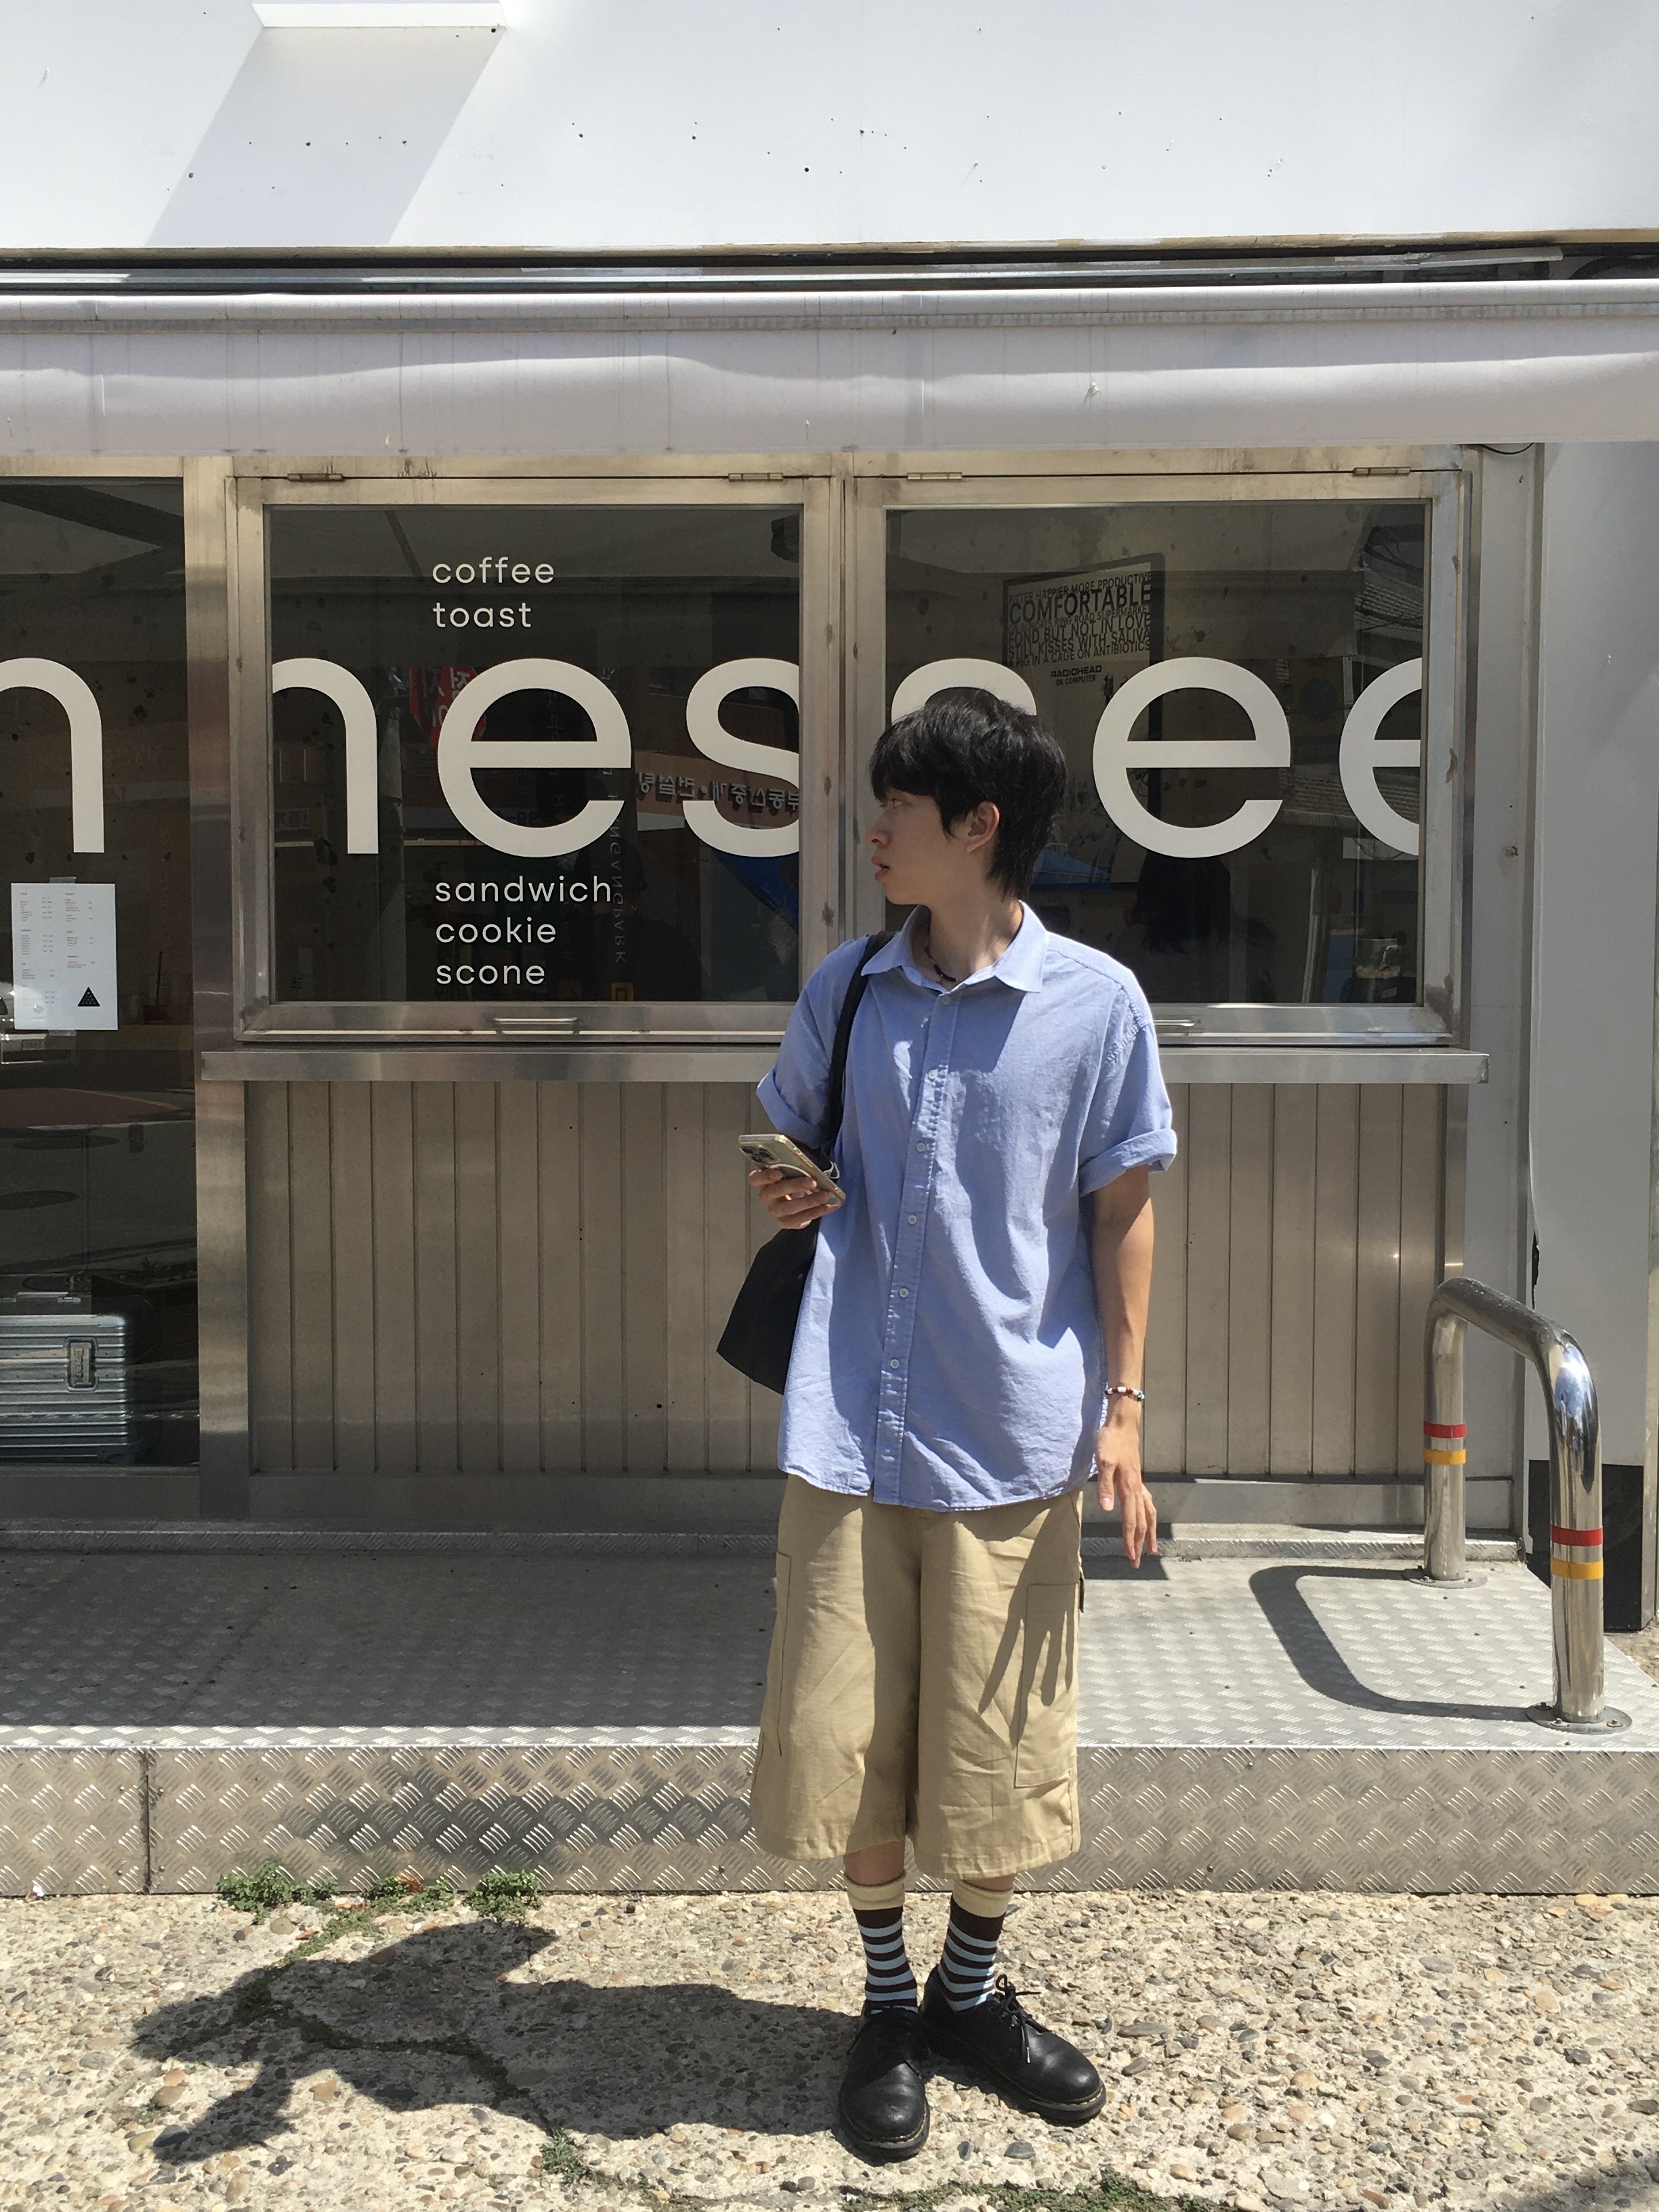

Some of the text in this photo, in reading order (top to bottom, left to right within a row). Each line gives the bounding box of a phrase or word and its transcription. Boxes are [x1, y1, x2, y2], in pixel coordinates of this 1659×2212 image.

[432, 556, 554, 584] coffee
[1036, 586, 1068, 600] HAPPIER
[1071, 581, 1095, 594] MORE
[1097, 572, 1151, 589] PRODUCTIVE
[432, 602, 531, 628] toast
[1010, 582, 1152, 624] COMFORTABLE
[1045, 625, 1066, 643] BUT
[1072, 620, 1097, 639] NOT
[1101, 618, 1113, 634] IN
[1118, 612, 1150, 631] LOVE
[1074, 612, 1095, 623] ROAD
[1051, 650, 1075, 662] CAGE
[1078, 648, 1090, 659] ON
[1093, 639, 1150, 657] ANTIBIOTICS
[1078, 633, 1106, 650] WITH
[1111, 625, 1150, 644] SALIVA
[1051, 665, 1102, 678] RADIOHEAD
[1066, 675, 1096, 685] COMPUTER
[435, 875, 610, 902] sandwich
[436, 916, 556, 943] cookie
[436, 965, 545, 985] scone
